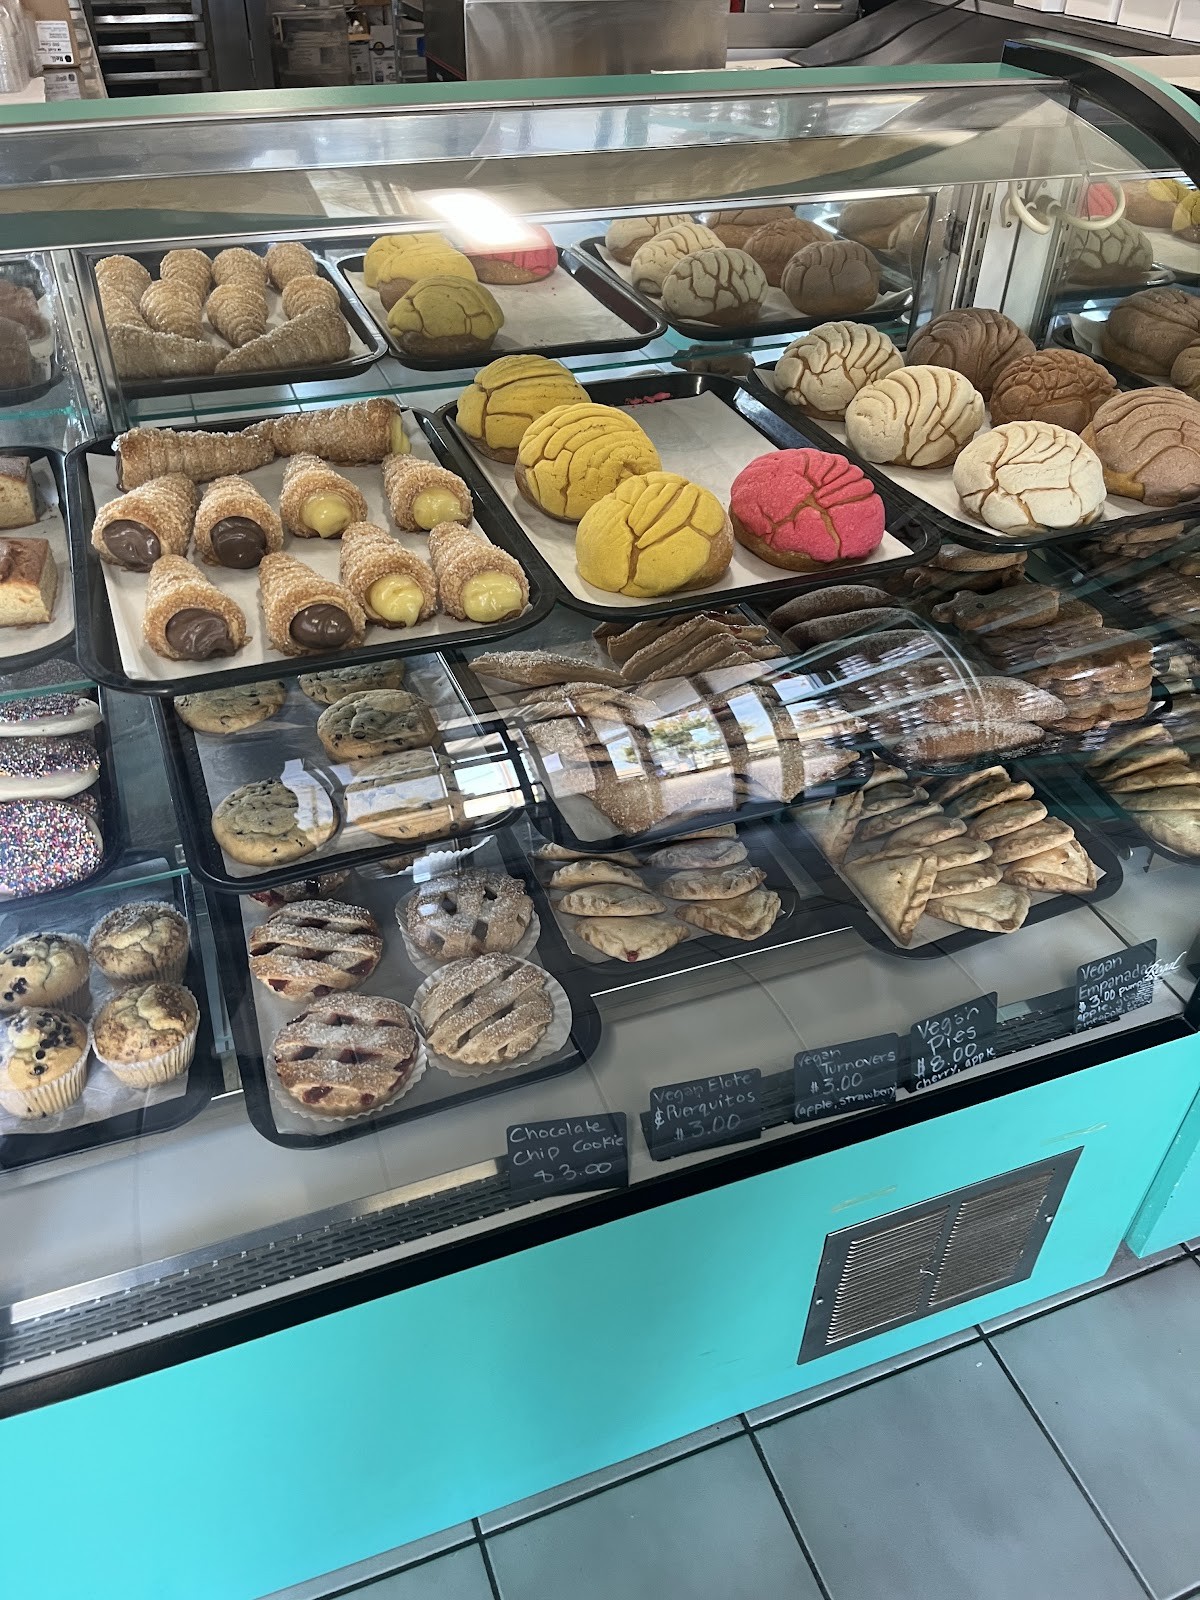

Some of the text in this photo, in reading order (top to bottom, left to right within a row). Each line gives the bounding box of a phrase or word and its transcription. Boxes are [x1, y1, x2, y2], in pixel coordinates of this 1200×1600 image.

[1081, 956, 1122, 981] Vegan
[917, 1007, 979, 1040] Vegan
[927, 1026, 977, 1056] Pies
[821, 1051, 896, 1075] Turnovers
[509, 1121, 606, 1143] Chocolate
[513, 1134, 624, 1166] Chip Cookie
